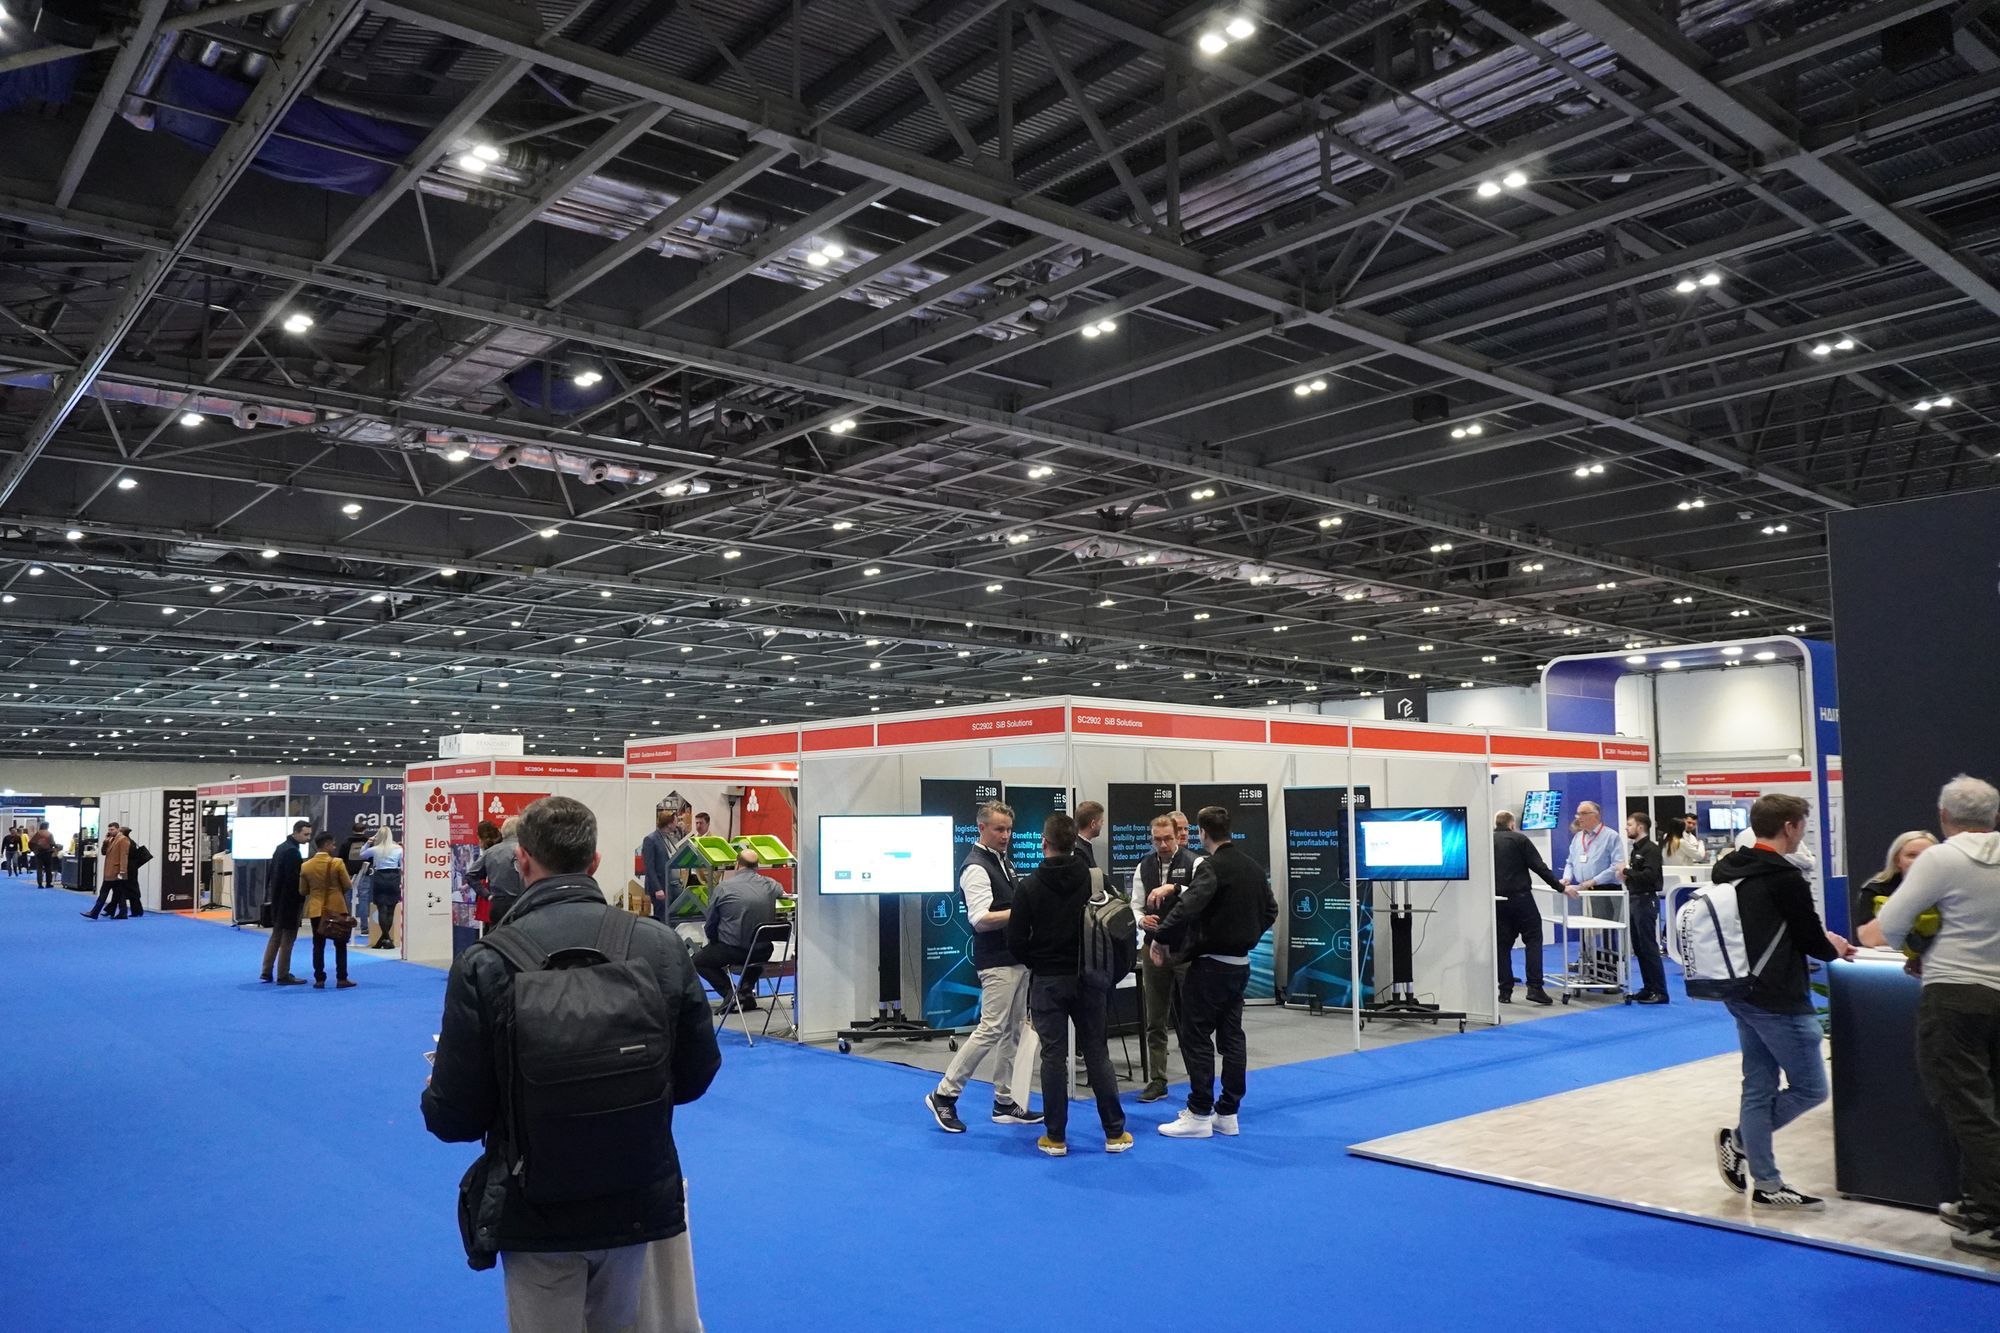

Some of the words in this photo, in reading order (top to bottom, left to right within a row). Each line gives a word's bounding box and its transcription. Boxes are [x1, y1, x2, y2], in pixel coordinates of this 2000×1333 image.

[972, 722, 993, 731] SC2902
[995, 720, 1006, 729] SiB
[1006, 718, 1033, 728] Solutions
[1077, 715, 1101, 725] SC2902
[1104, 717, 1116, 726] SiB
[1116, 718, 1143, 728] Solutions
[984, 786, 998, 797] SiB
[1161, 790, 1173, 799] SiB
[1249, 789, 1263, 799] SiB
[182, 799, 195, 809] 11
[1353, 794, 1366, 804] SiB
[354, 812, 403, 827] cana
[168, 799, 181, 862] SEMINAR
[954, 824, 980, 834] logistic
[1112, 824, 1133, 832] Benefit
[1133, 824, 1146, 832] from
[1012, 831, 1033, 840] Benefit
[1033, 831, 1042, 840] fro
[1112, 833, 1136, 842] visibility
[1136, 833, 1147, 841] and
[1231, 831, 1247, 840] less
[1289, 829, 1319, 837] Flawless
[1319, 829, 1339, 839] logist
[181, 814, 195, 876] THEATRE
[425, 839, 451, 849] Elev
[964, 835, 980, 845] logi
[1290, 839, 1296, 847] is
[1296, 839, 1330, 848] profitable
[1012, 841, 1037, 850] visibility
[425, 853, 451, 866] logi
[1013, 861, 1031, 869] Video
[425, 870, 451, 879] nex
